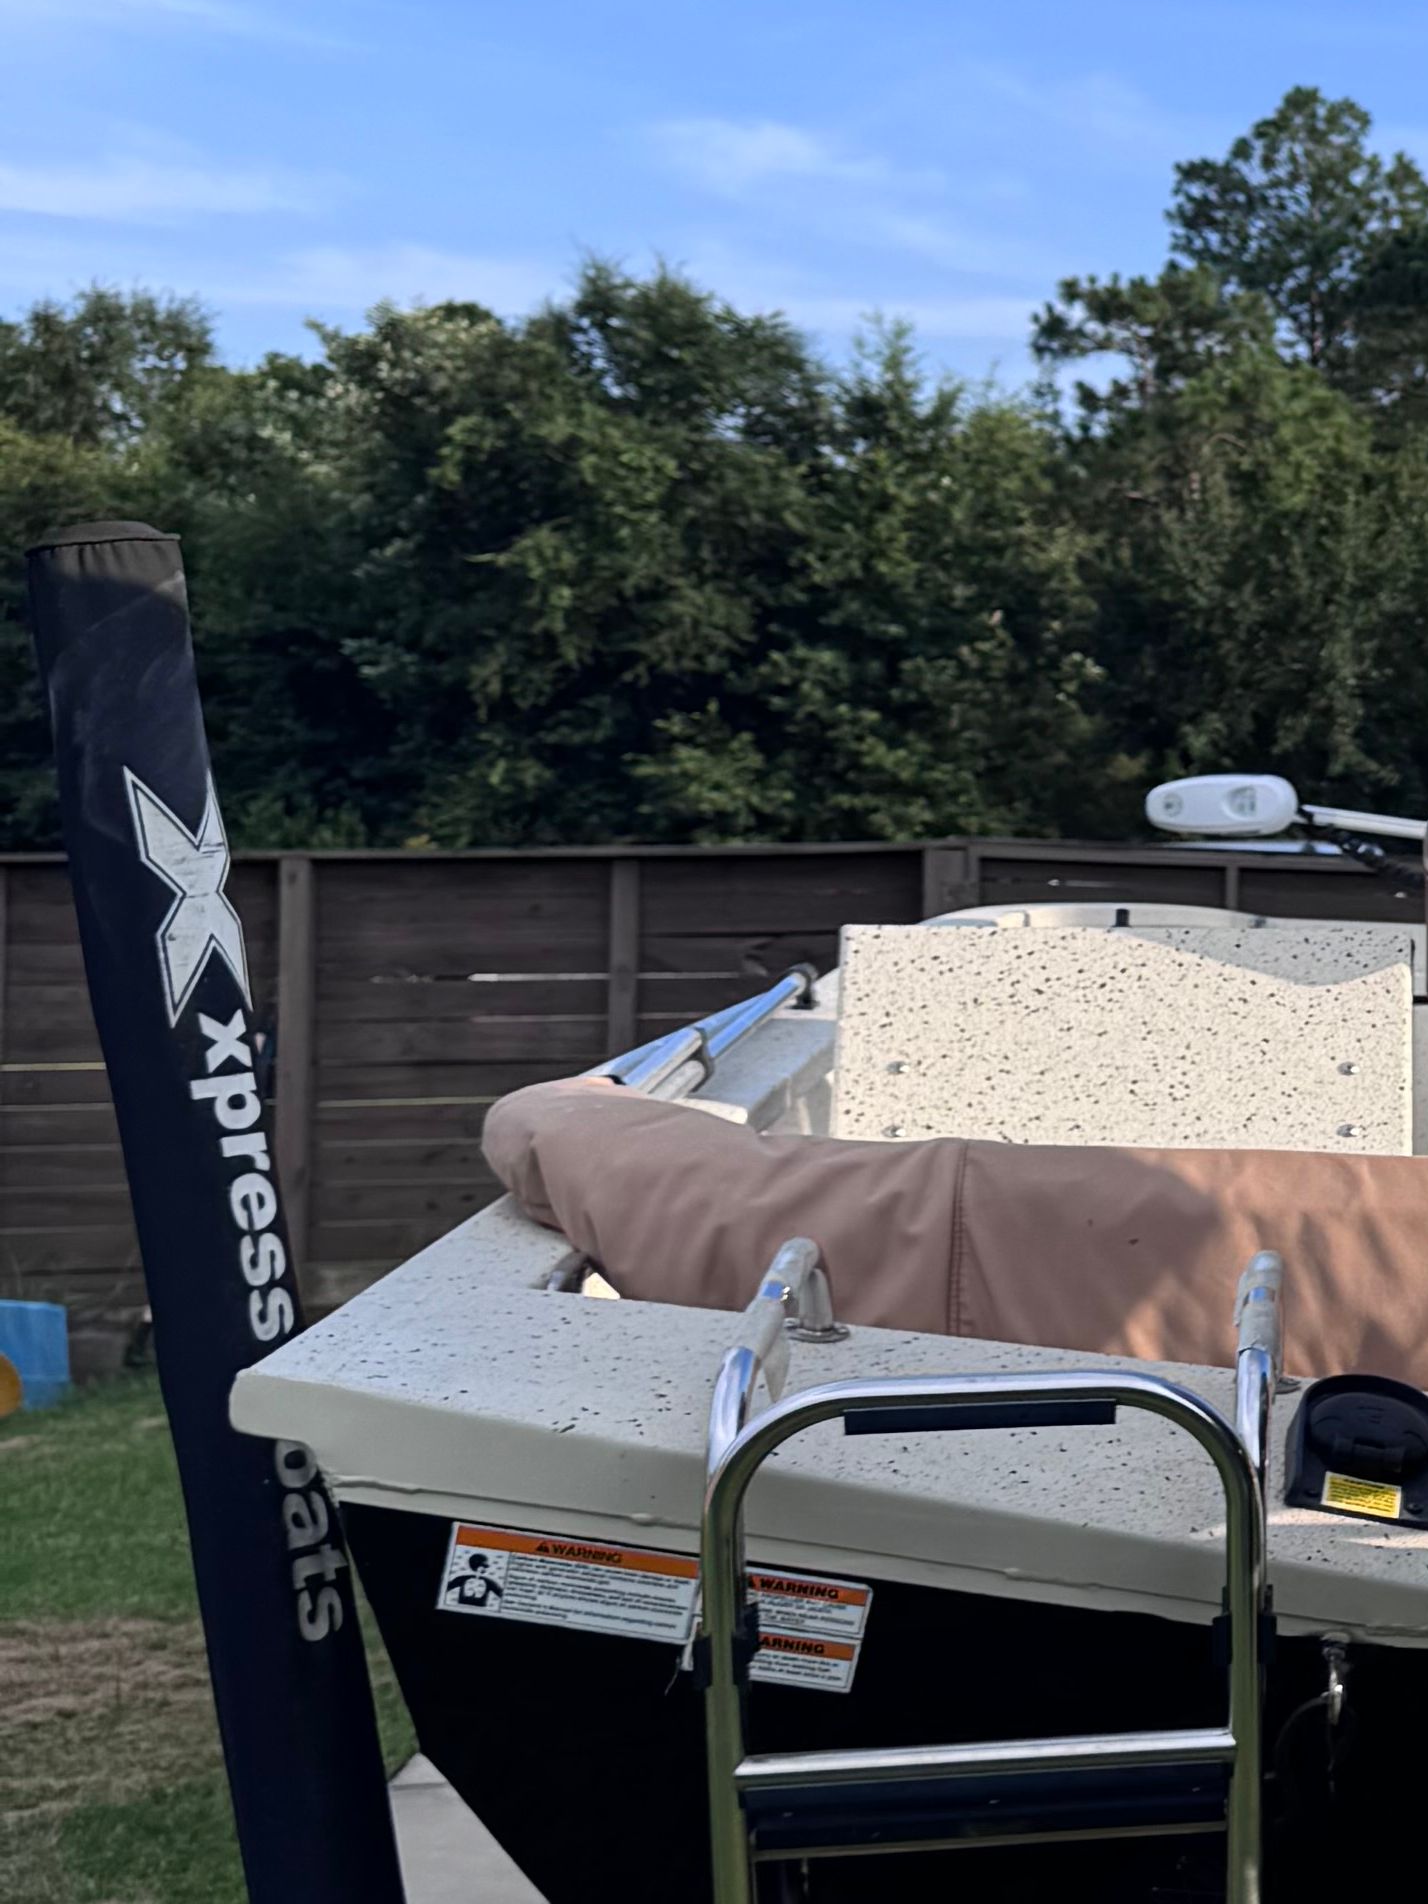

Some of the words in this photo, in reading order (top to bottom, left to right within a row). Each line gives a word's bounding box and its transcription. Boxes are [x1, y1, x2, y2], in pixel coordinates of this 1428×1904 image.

[189, 1007, 295, 1342] xpress
[274, 1439, 350, 1642] oats
[552, 1543, 623, 1564] WARNING
[759, 1577, 839, 1599] WARNING
[760, 1635, 825, 1654] ARNING
